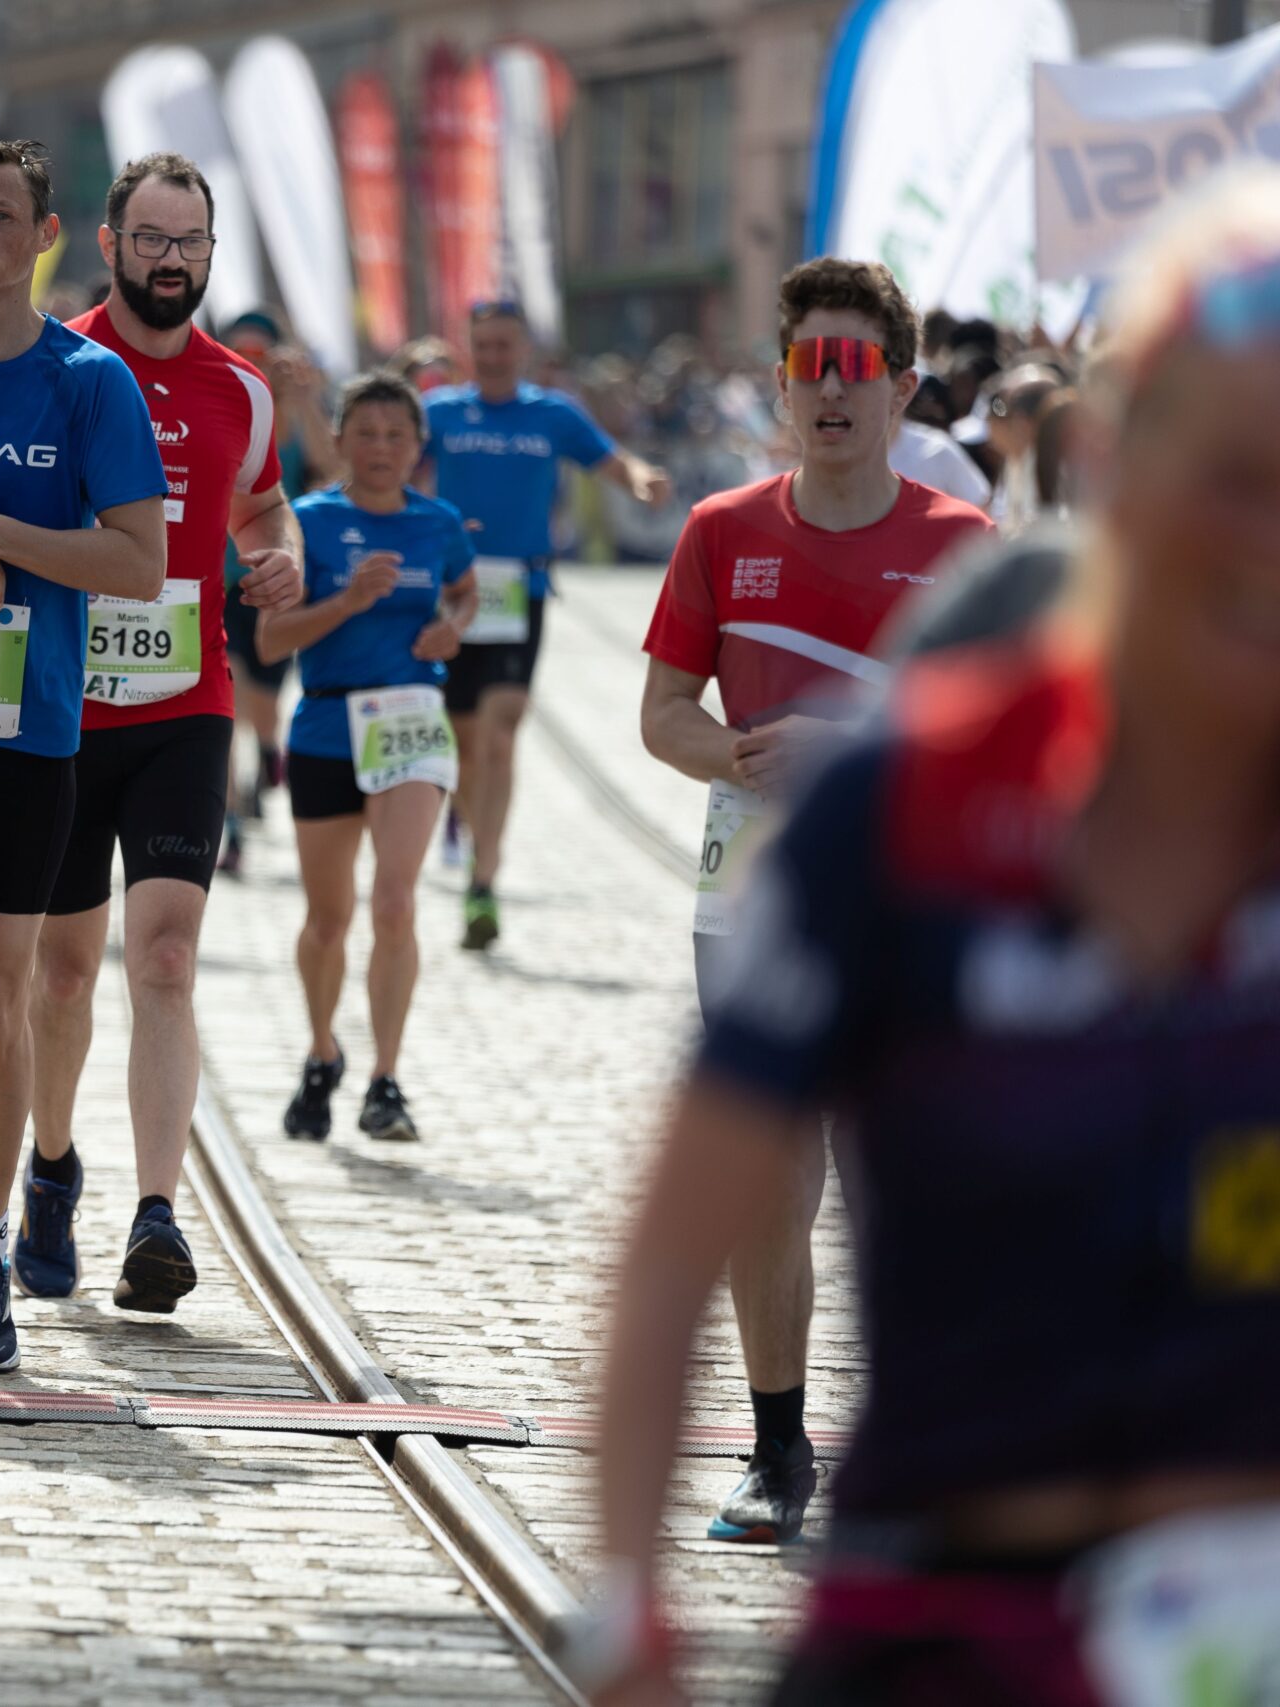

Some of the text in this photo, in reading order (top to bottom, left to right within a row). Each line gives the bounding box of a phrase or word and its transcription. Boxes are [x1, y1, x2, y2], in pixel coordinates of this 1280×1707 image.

[154, 432, 179, 442] UN
[166, 479, 188, 494] eal
[746, 558, 783, 568] SWIM
[743, 568, 780, 577] BIKE
[742, 578, 779, 588] RUN
[731, 588, 777, 599] ENNS
[117, 612, 150, 624] Martin
[89, 625, 172, 658] 5189
[84, 674, 121, 699] AT
[700, 840, 724, 875] 0
